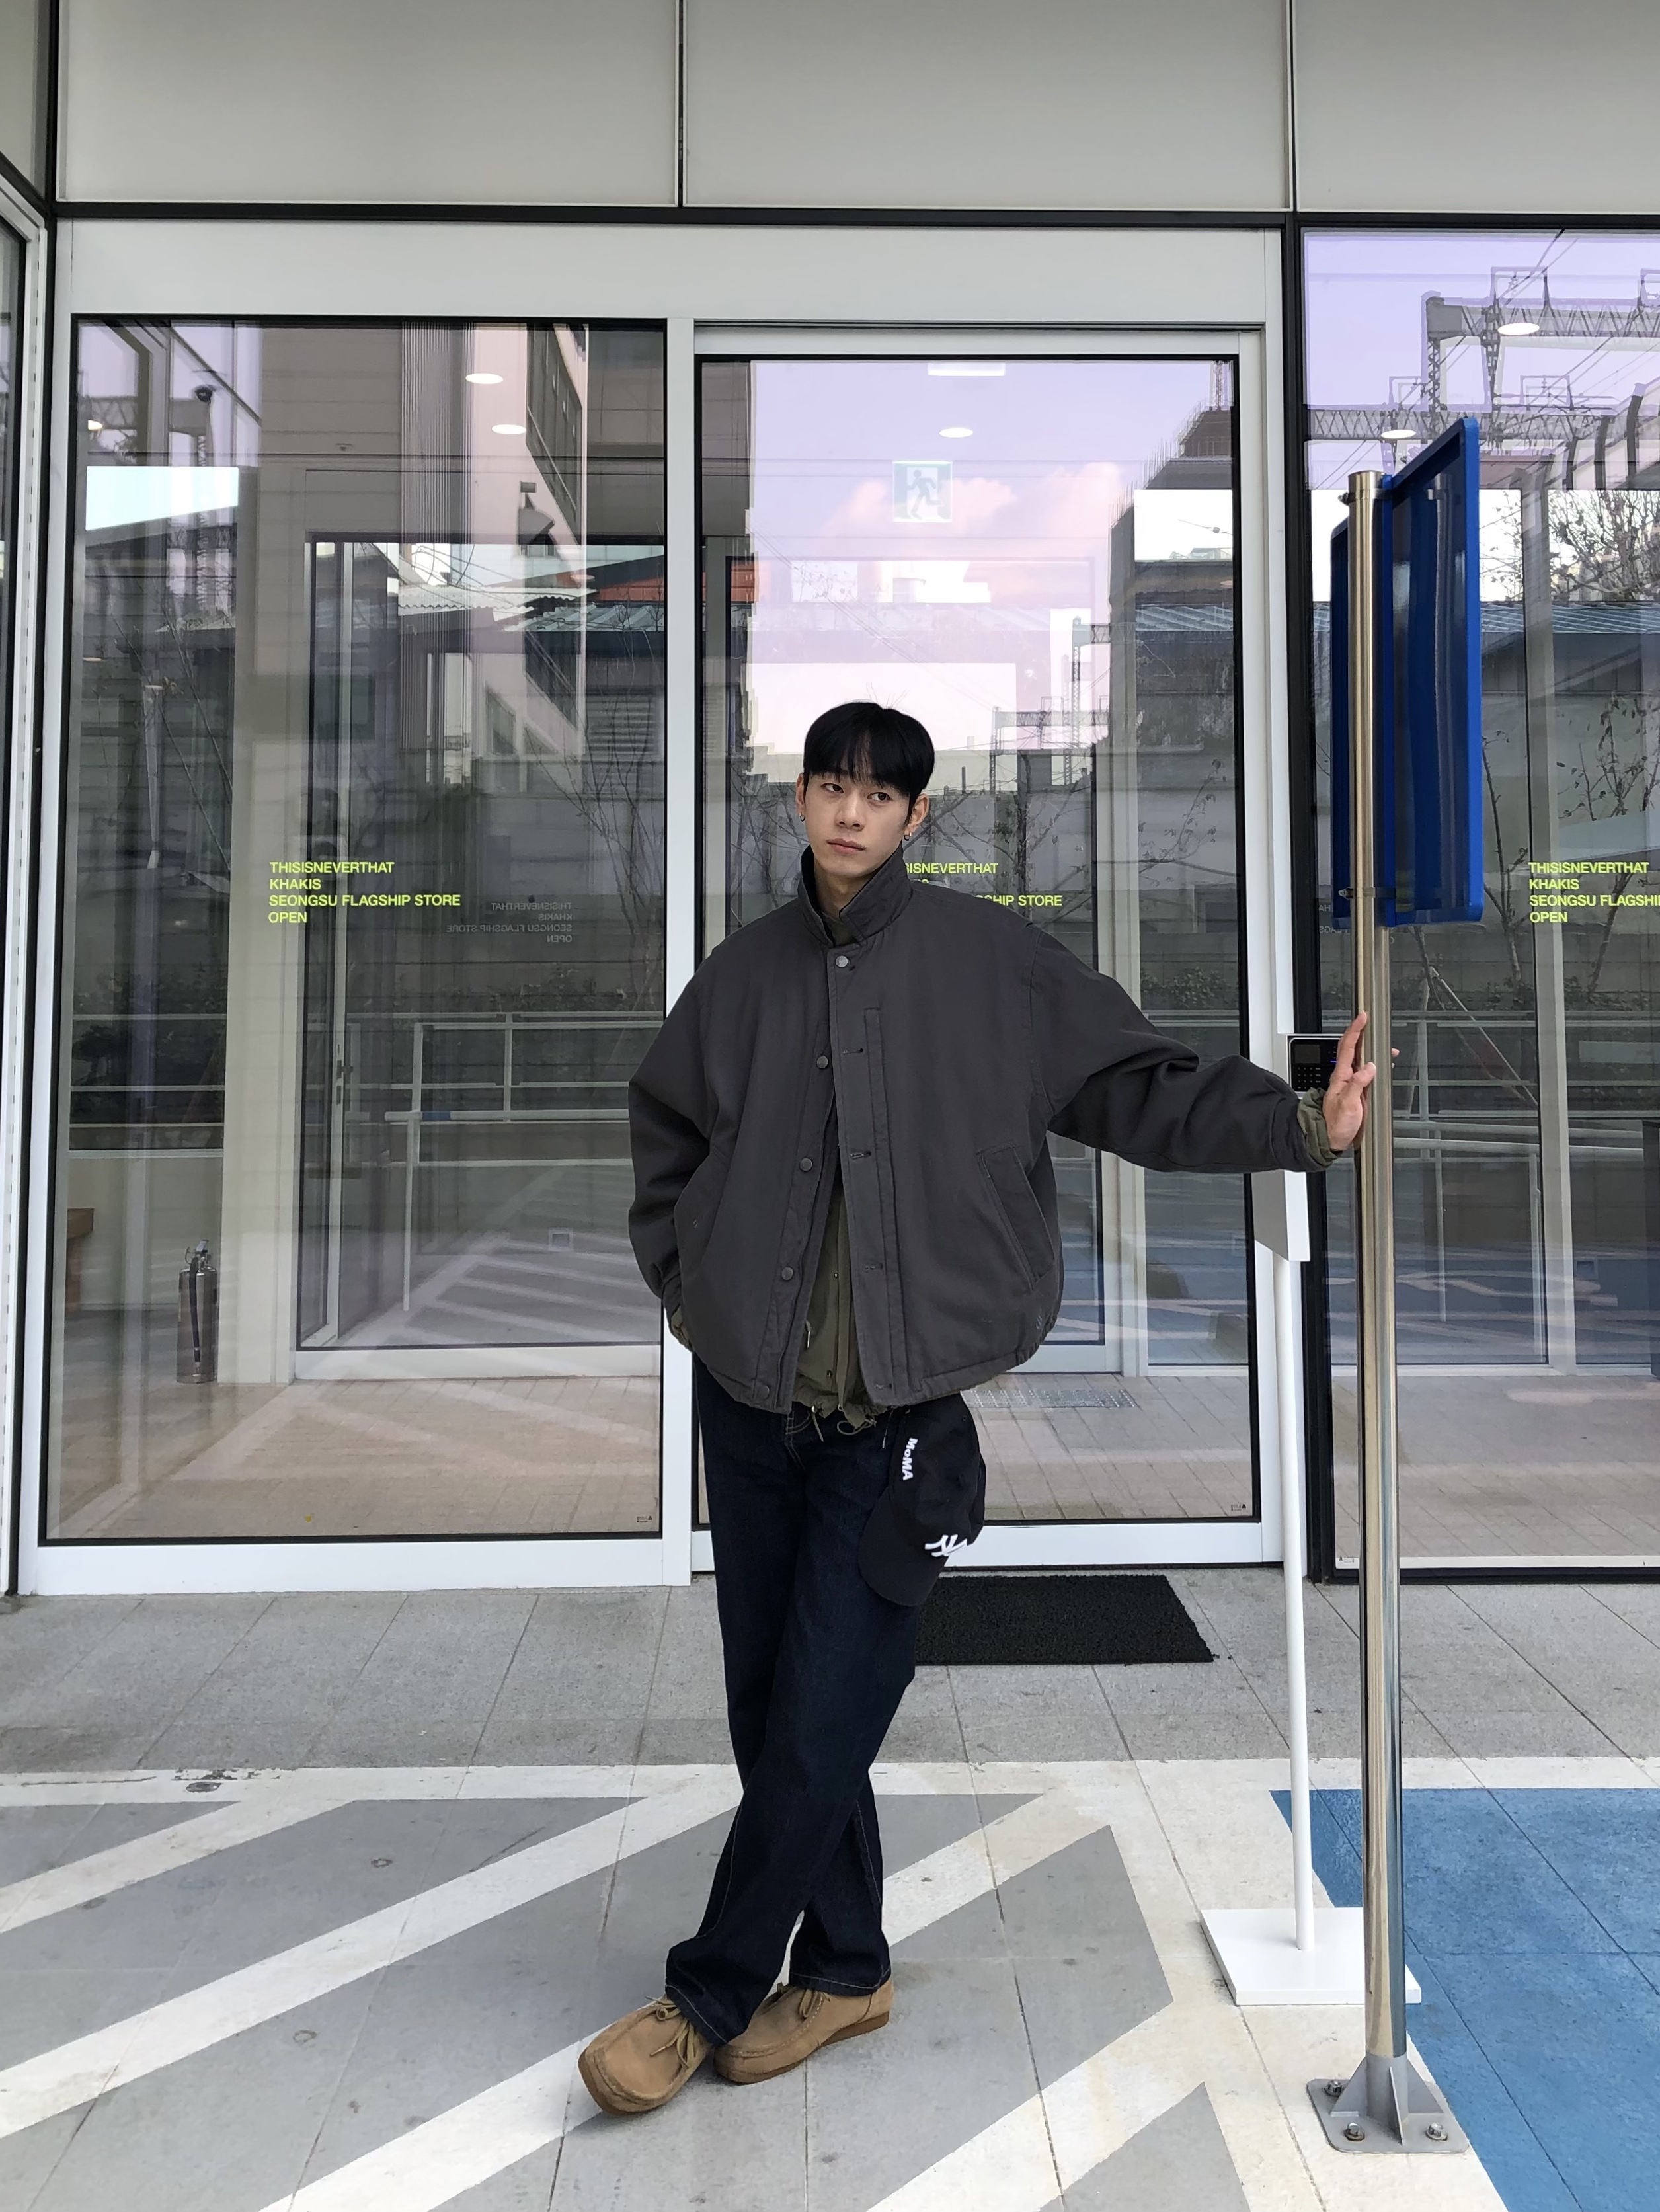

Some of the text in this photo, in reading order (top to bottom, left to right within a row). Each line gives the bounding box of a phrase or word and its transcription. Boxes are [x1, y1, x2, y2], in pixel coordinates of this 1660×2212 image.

[270, 861, 395, 873] THISISNEVERTHAT
[1528, 861, 1649, 873] THISISNEVERTHAT
[269, 878, 322, 890] KHAKIS
[1528, 878, 1580, 890] KHAKIS
[268, 894, 461, 907] SEONGSU FLAGSHIP STORE
[1018, 894, 1063, 907] STORE
[1529, 894, 1660, 907] SEONGSU FLAGSHI
[268, 910, 308, 924] OPEN
[1529, 911, 1569, 924] OPEN
[902, 1437, 918, 1481] MoMA
